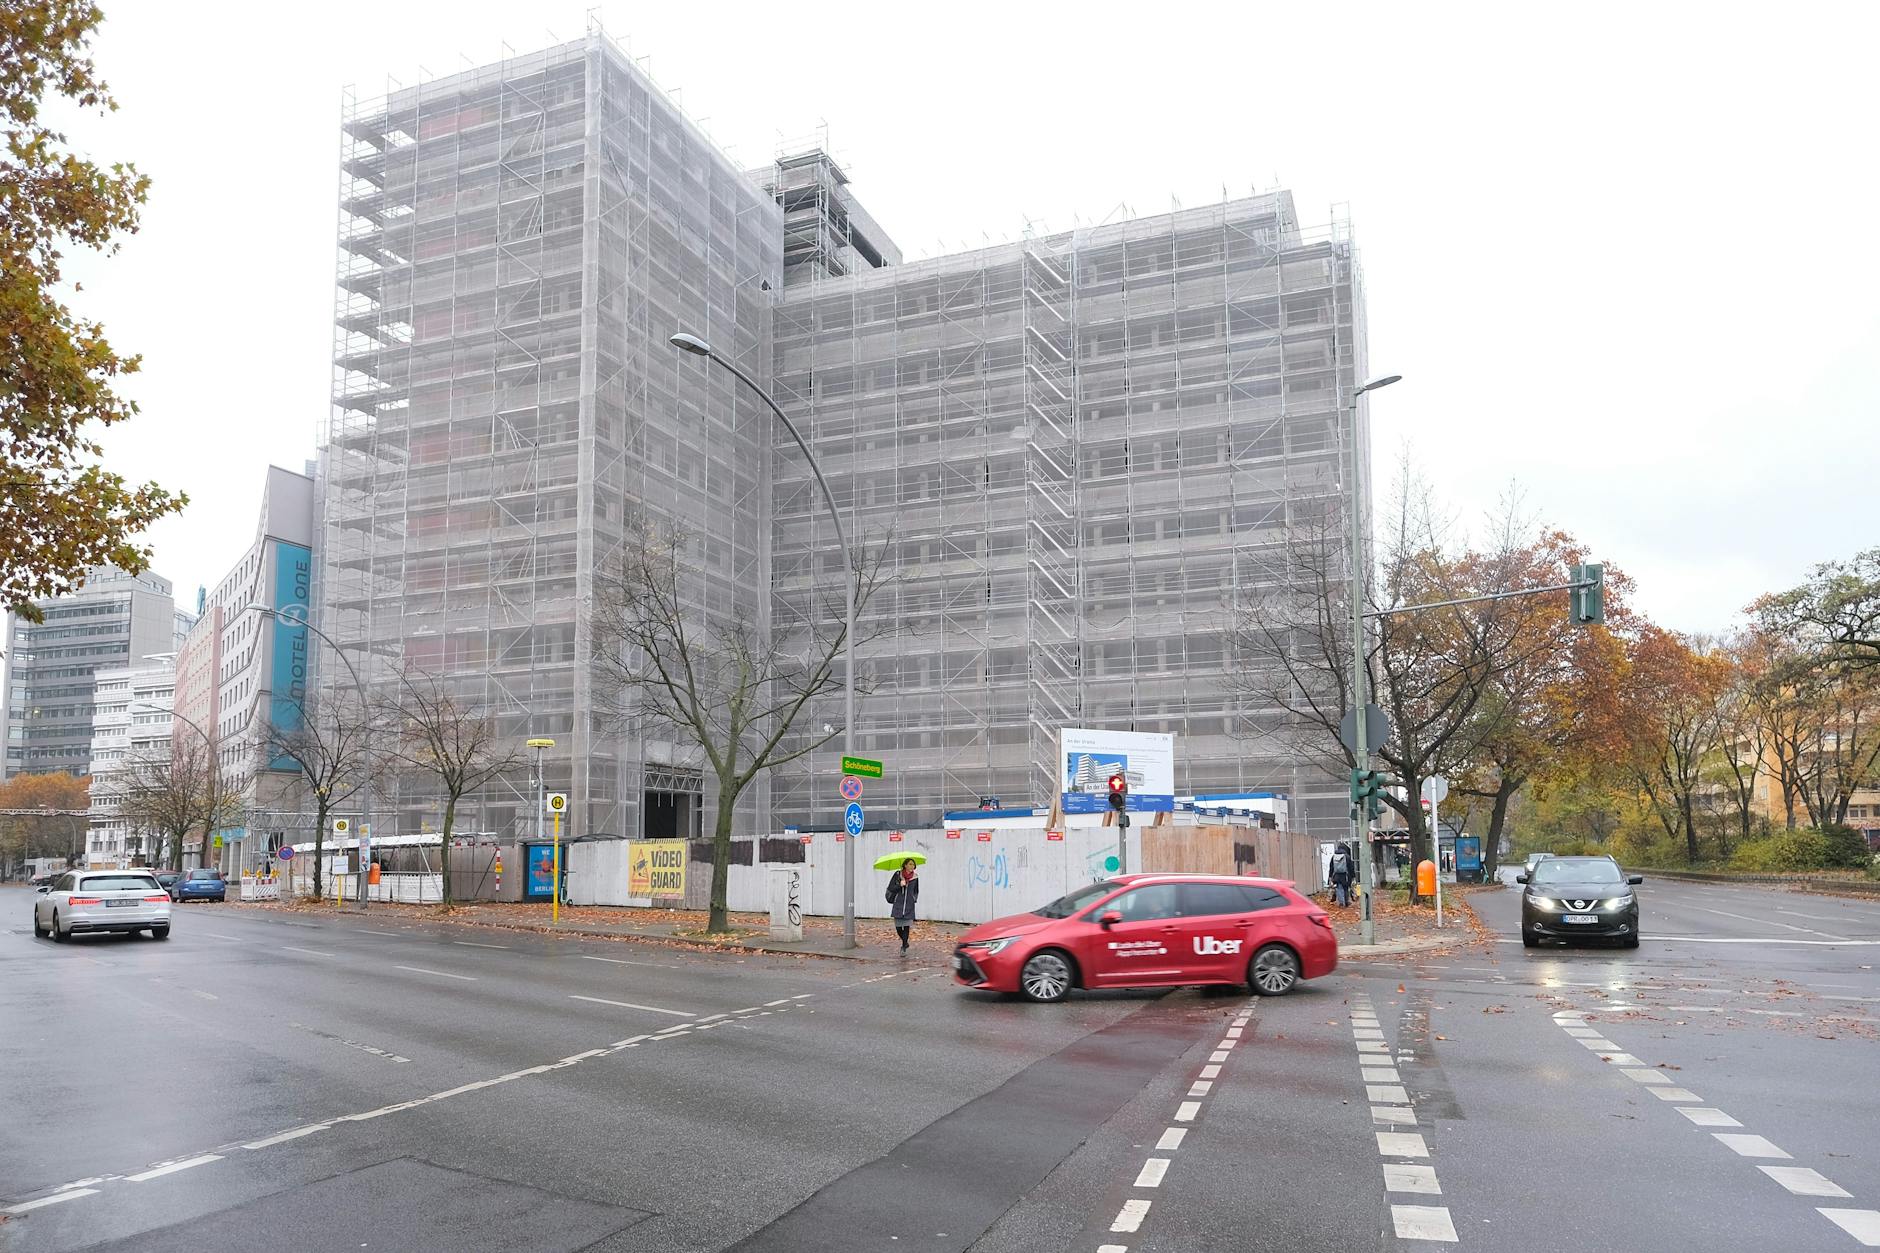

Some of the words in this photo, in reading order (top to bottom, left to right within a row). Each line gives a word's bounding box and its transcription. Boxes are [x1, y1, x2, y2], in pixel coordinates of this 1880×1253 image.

[845, 760, 880, 773] Schöneberg
[651, 871, 682, 889] GUARD
[1193, 936, 1243, 955] Uber
